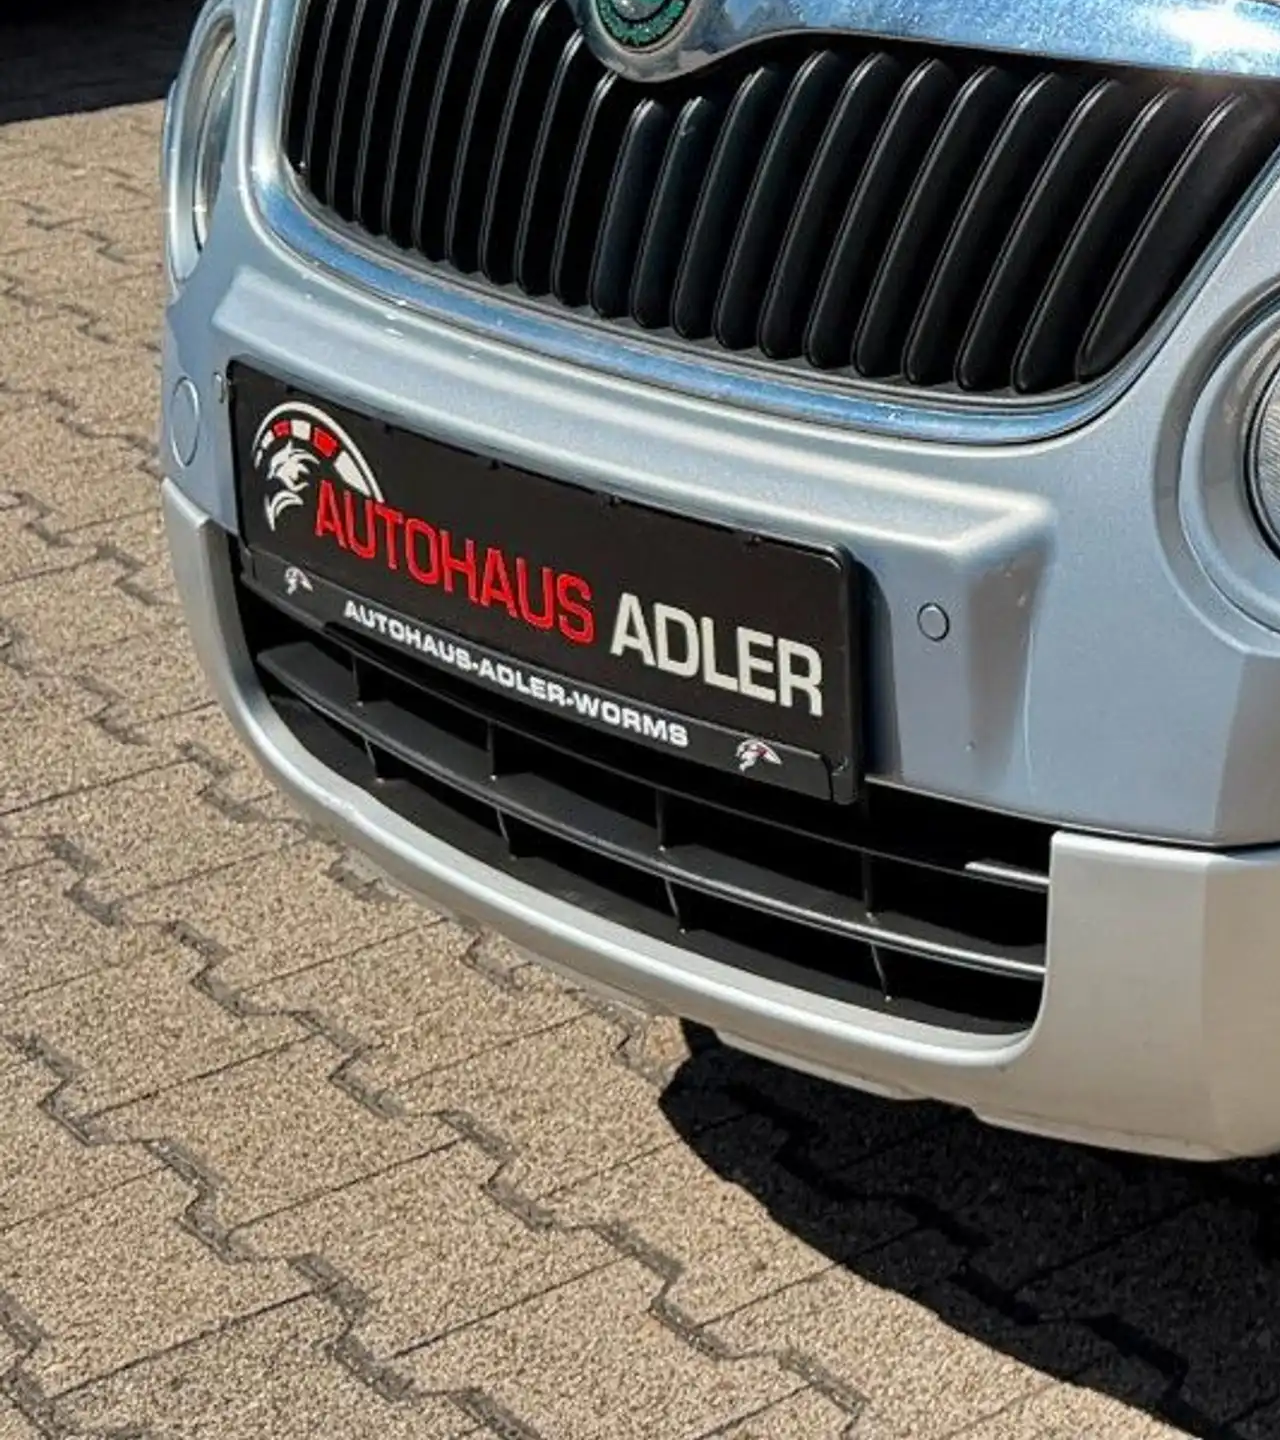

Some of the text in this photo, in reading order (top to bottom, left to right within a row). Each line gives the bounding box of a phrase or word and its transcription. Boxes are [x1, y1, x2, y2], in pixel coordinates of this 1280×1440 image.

[314, 478, 823, 718] AUTOHAUS ADLER
[343, 599, 690, 749] AUTOHAUS-ADLER-WORMS
